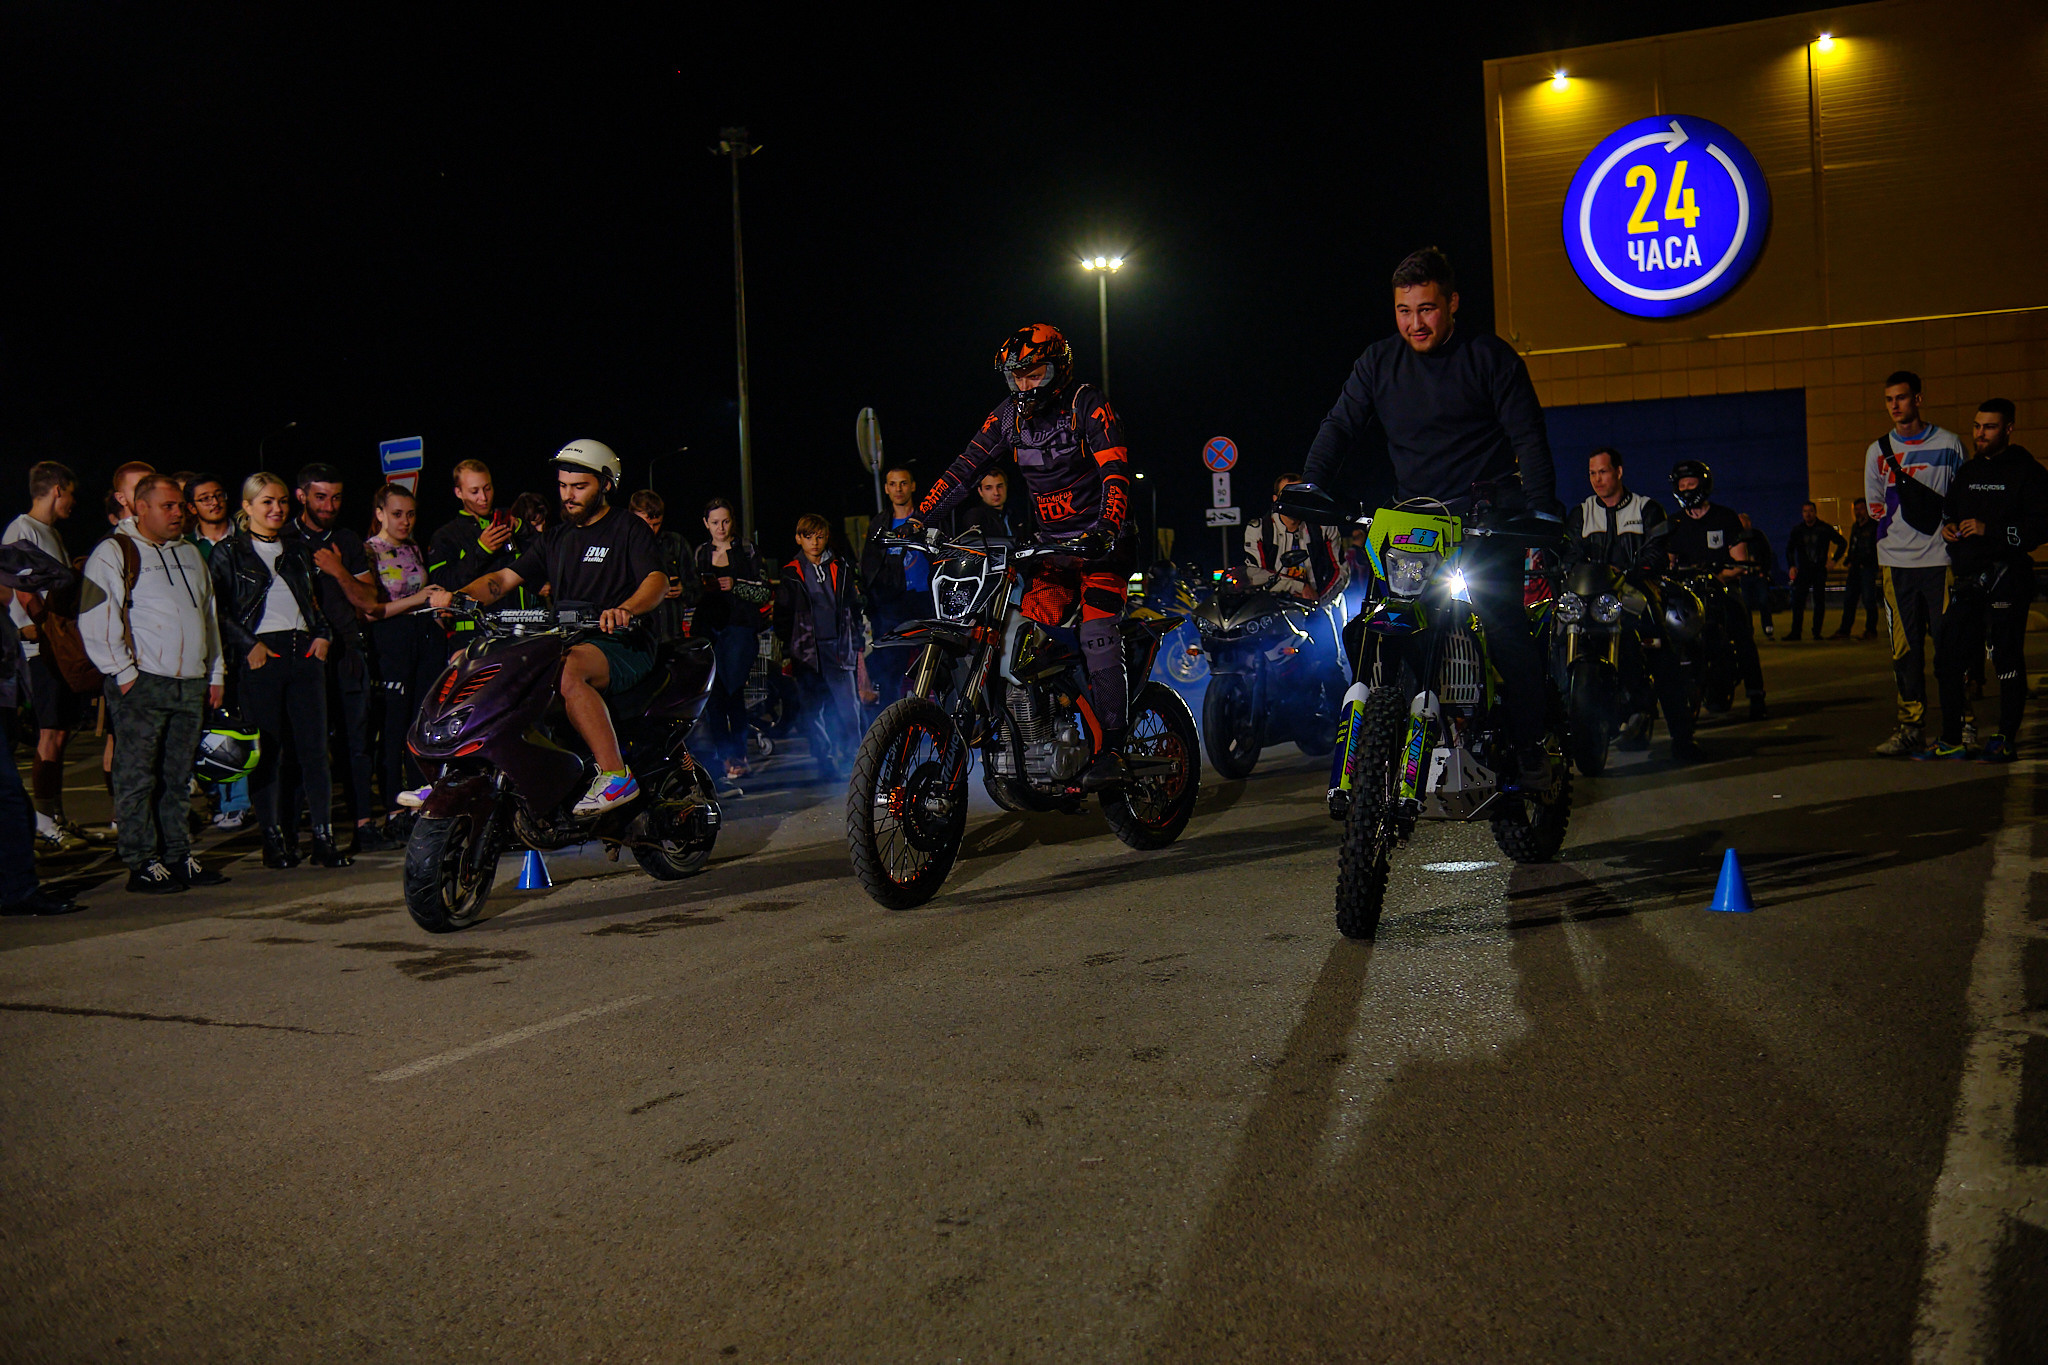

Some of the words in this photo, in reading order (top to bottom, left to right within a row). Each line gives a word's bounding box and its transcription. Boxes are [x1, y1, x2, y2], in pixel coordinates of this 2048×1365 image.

[1625, 160, 1700, 235] 24
[1627, 234, 1702, 272] ЧАСА
[1038, 496, 1077, 521] FOX
[1088, 636, 1114, 649] FOX
